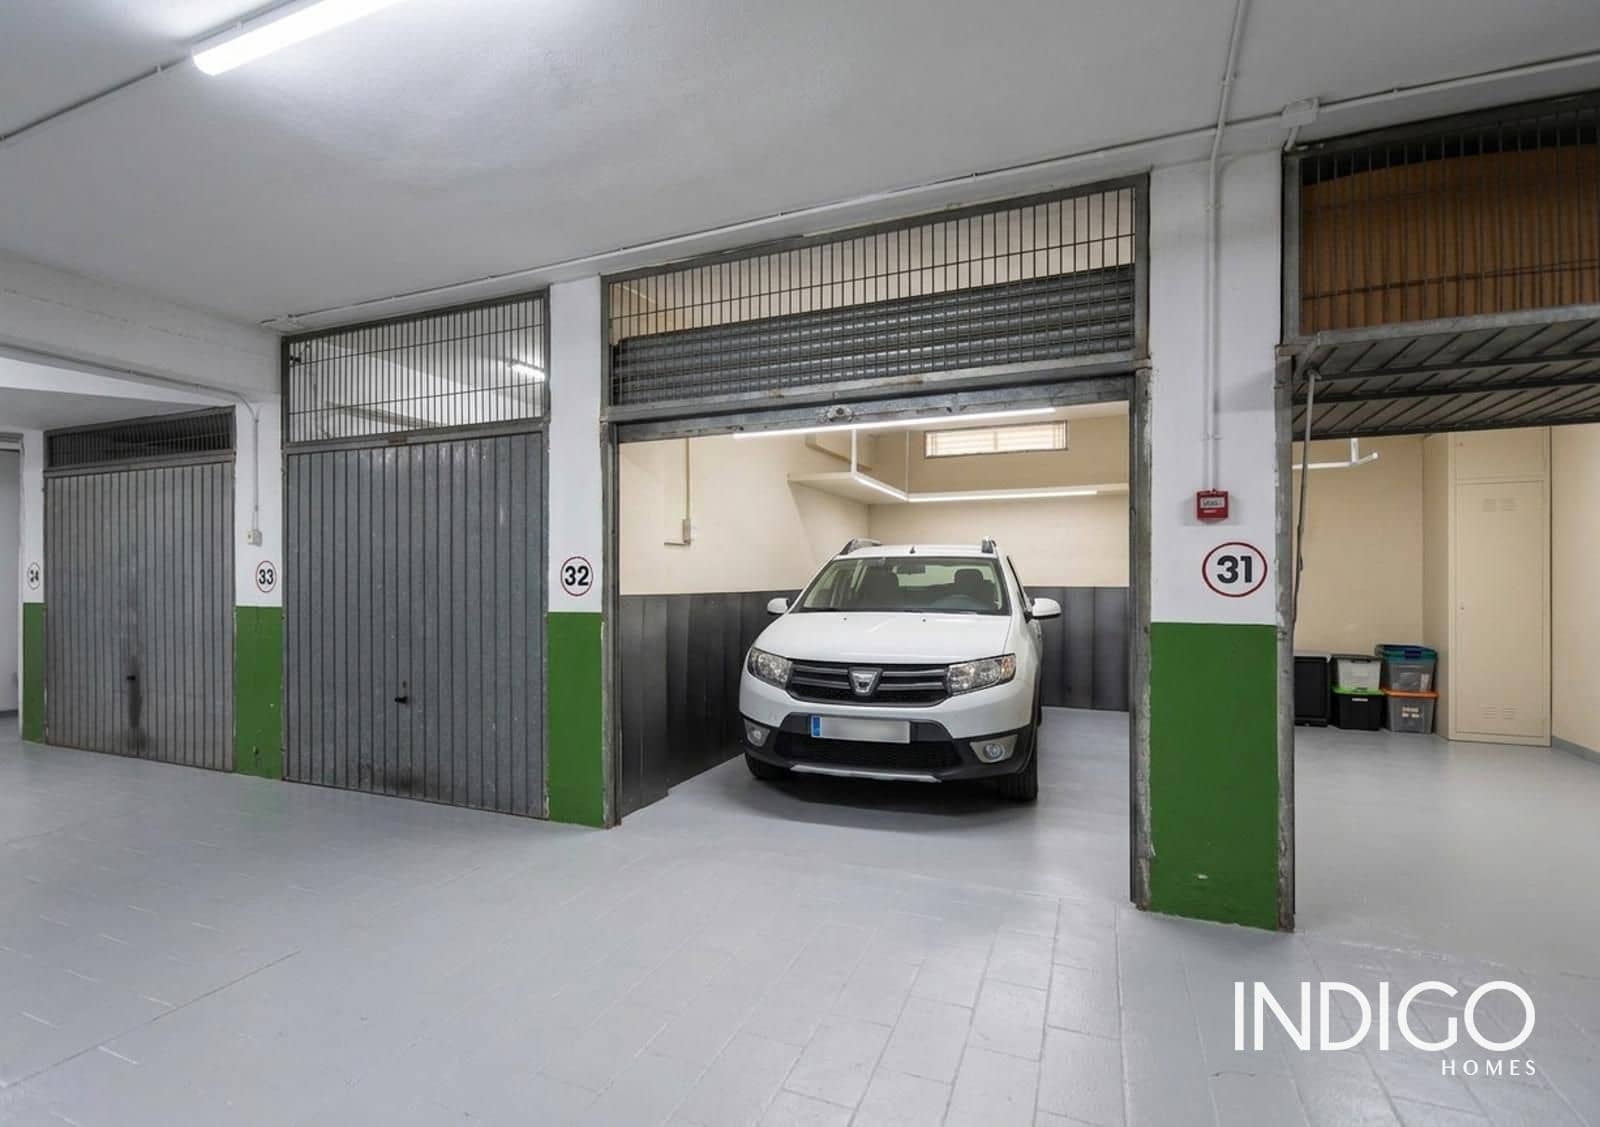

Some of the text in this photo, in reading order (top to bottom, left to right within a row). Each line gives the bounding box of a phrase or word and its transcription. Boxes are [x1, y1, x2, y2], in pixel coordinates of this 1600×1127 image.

[259, 568, 274, 585] 33
[564, 565, 589, 586] 32
[1216, 555, 1253, 584] 31
